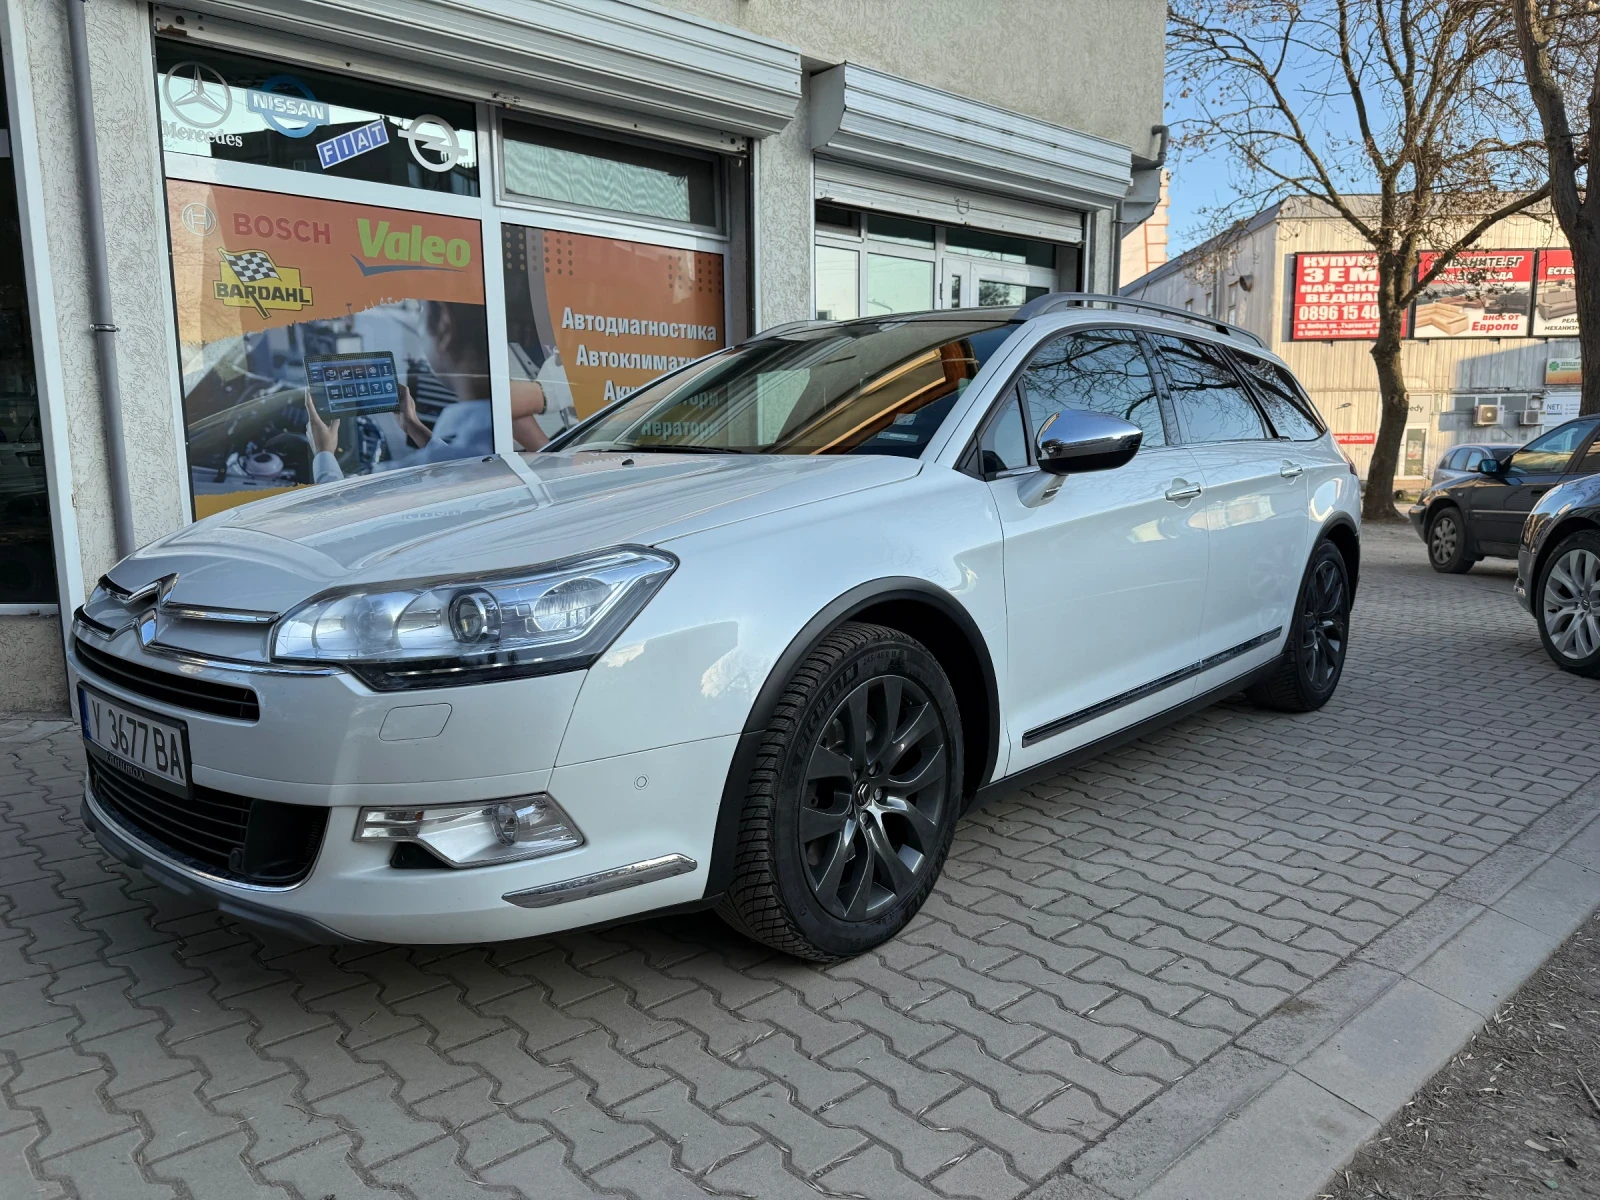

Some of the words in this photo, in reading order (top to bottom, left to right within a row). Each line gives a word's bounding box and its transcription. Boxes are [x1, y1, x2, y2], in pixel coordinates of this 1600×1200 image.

[253, 93, 324, 120] NISSAN
[161, 120, 243, 147] Mercedes
[320, 123, 386, 166] FIAT
[233, 212, 331, 245] BOSCH
[357, 218, 471, 268] Valeo
[1300, 283, 1379, 293] НАЙ-СКЪ
[1303, 267, 1377, 282] ЗЕМ
[216, 282, 312, 304] BARDAHL
[1305, 293, 1378, 303] ВЕДНА
[561, 306, 717, 342] Автодиагностика
[1298, 305, 1338, 320] 0896
[1341, 305, 1358, 320] 15
[1471, 321, 1519, 333] Европа
[108, 708, 148, 764] 3677
[152, 726, 184, 780] BA
